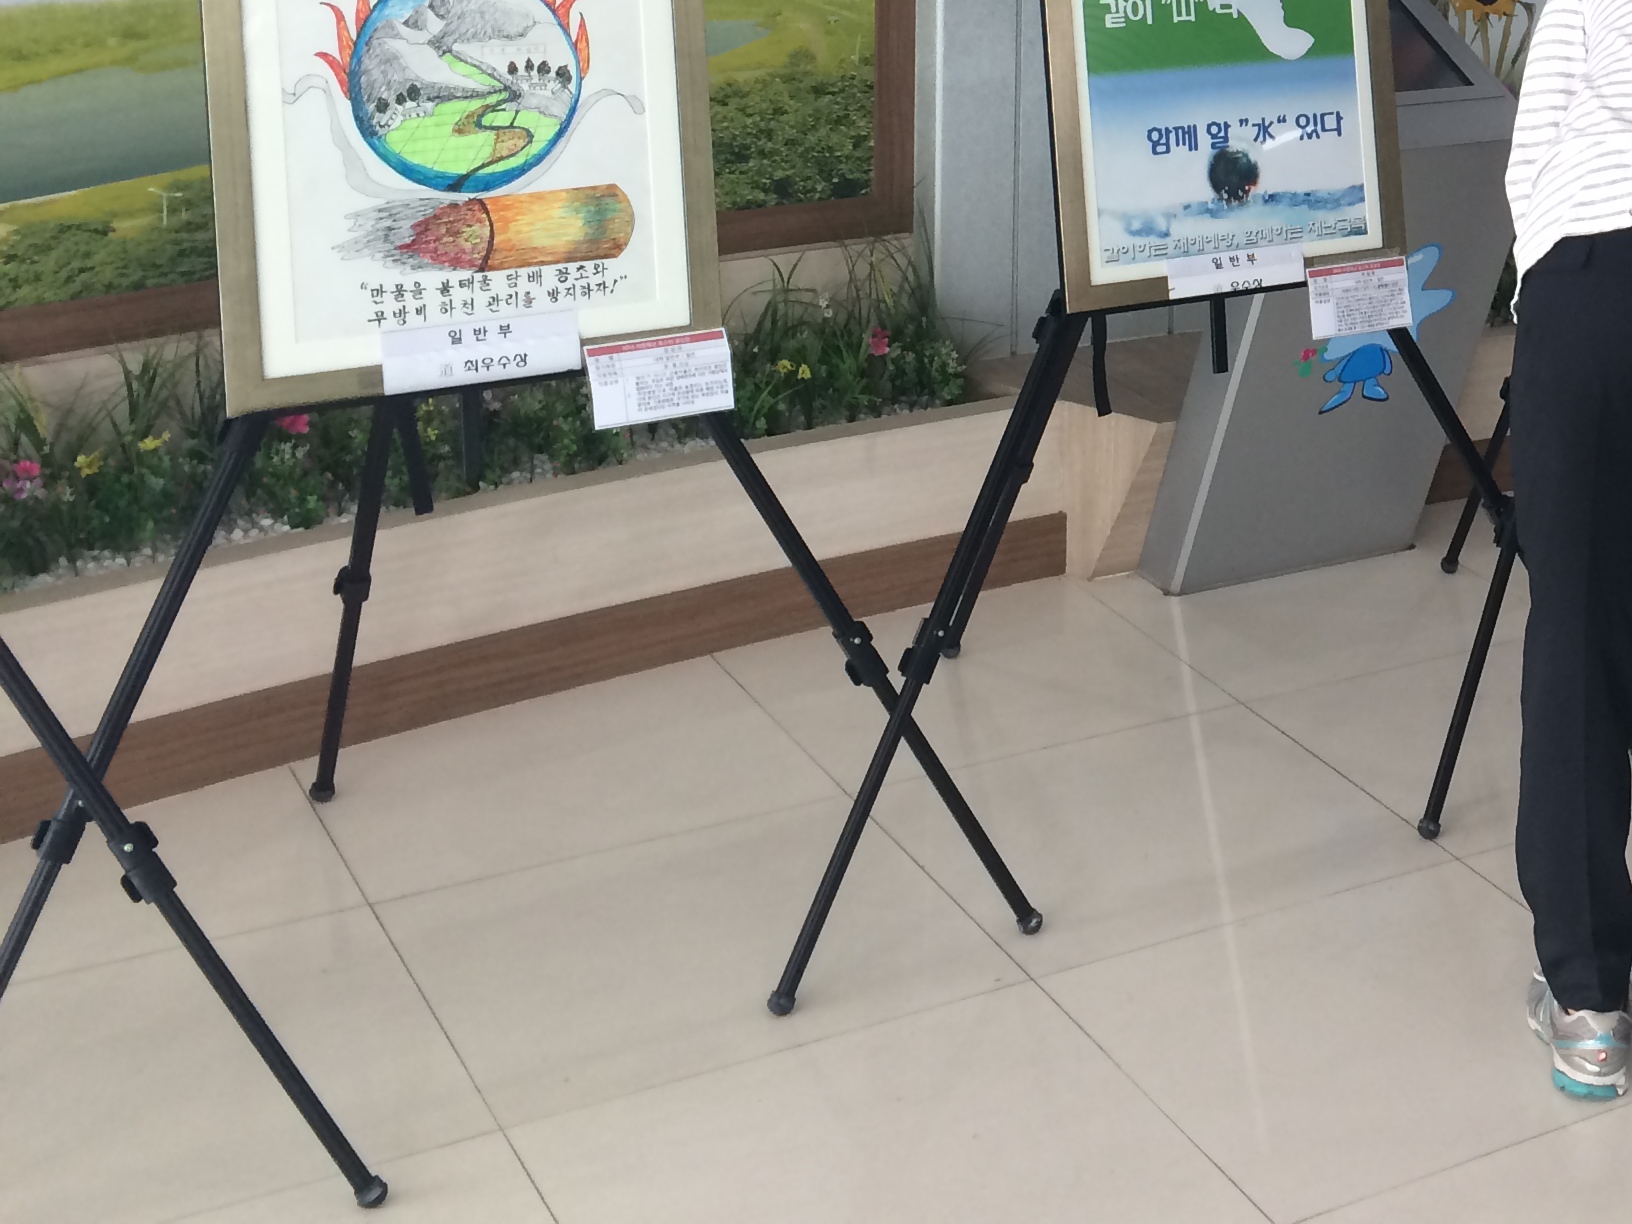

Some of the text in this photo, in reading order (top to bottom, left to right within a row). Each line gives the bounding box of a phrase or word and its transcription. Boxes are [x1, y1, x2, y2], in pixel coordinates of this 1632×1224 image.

[1147, 124, 1199, 156] 함께
[1206, 121, 1231, 151] 할
[1294, 111, 1344, 141] 있다
[1212, 252, 1258, 270] 일반부
[505, 269, 544, 289] 담배
[554, 262, 609, 284] 꽁초와
[367, 304, 428, 328] 무방비
[438, 297, 476, 319] 하천
[485, 291, 536, 314] 관리를
[447, 323, 513, 344] 일반부
[463, 352, 529, 374] 최우수상
